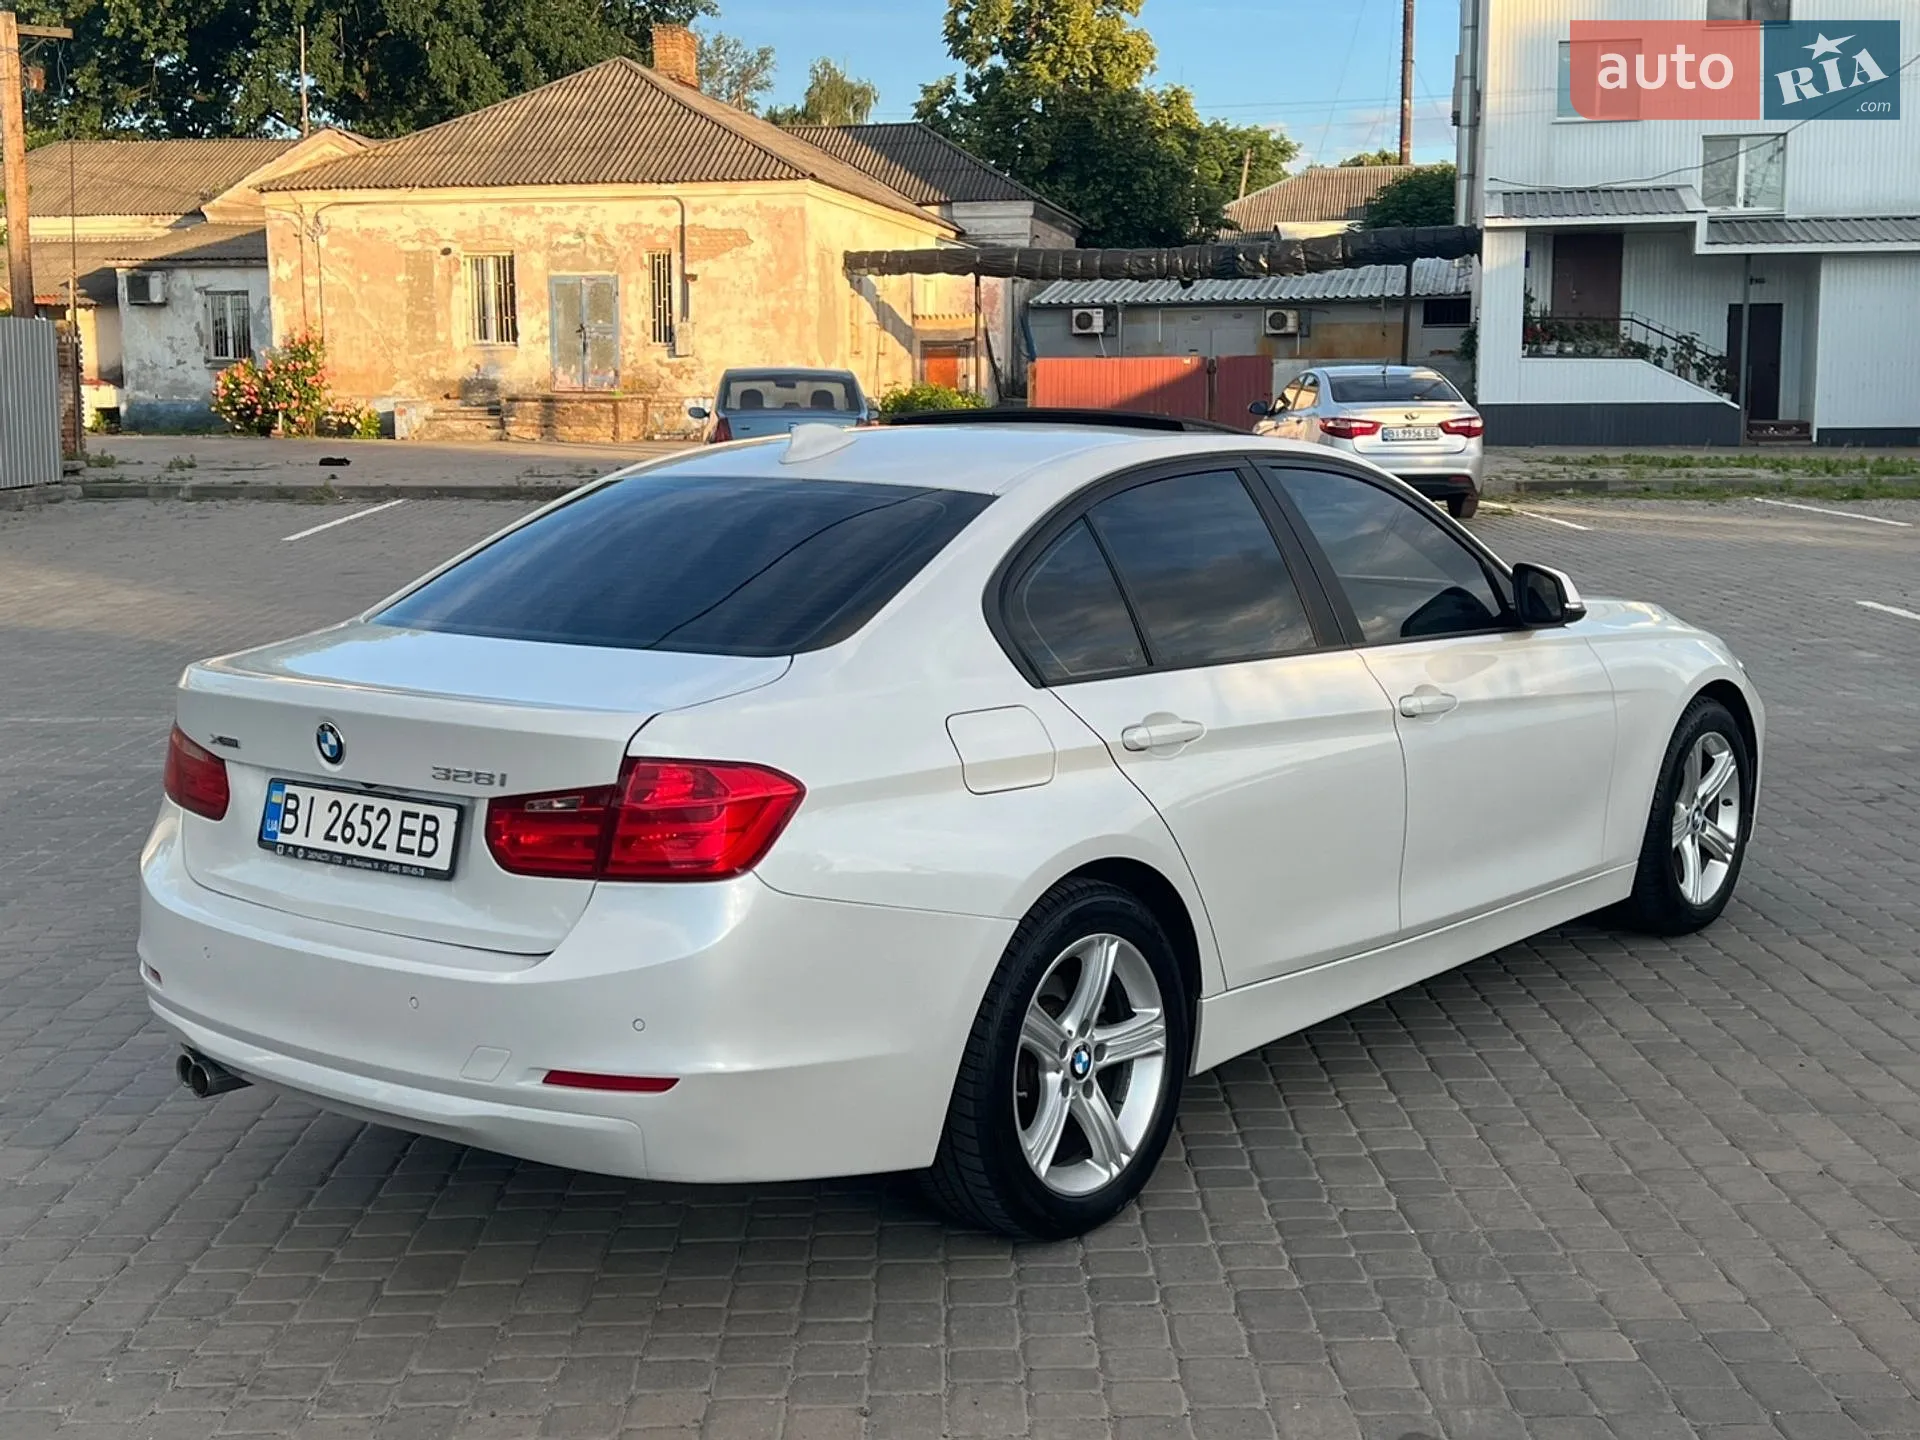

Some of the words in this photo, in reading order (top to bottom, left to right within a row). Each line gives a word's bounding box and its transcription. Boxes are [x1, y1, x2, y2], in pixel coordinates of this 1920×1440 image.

[267, 818, 279, 832] UA
[280, 793, 314, 838] BI
[323, 800, 391, 851] 2652
[396, 810, 440, 858] EB
